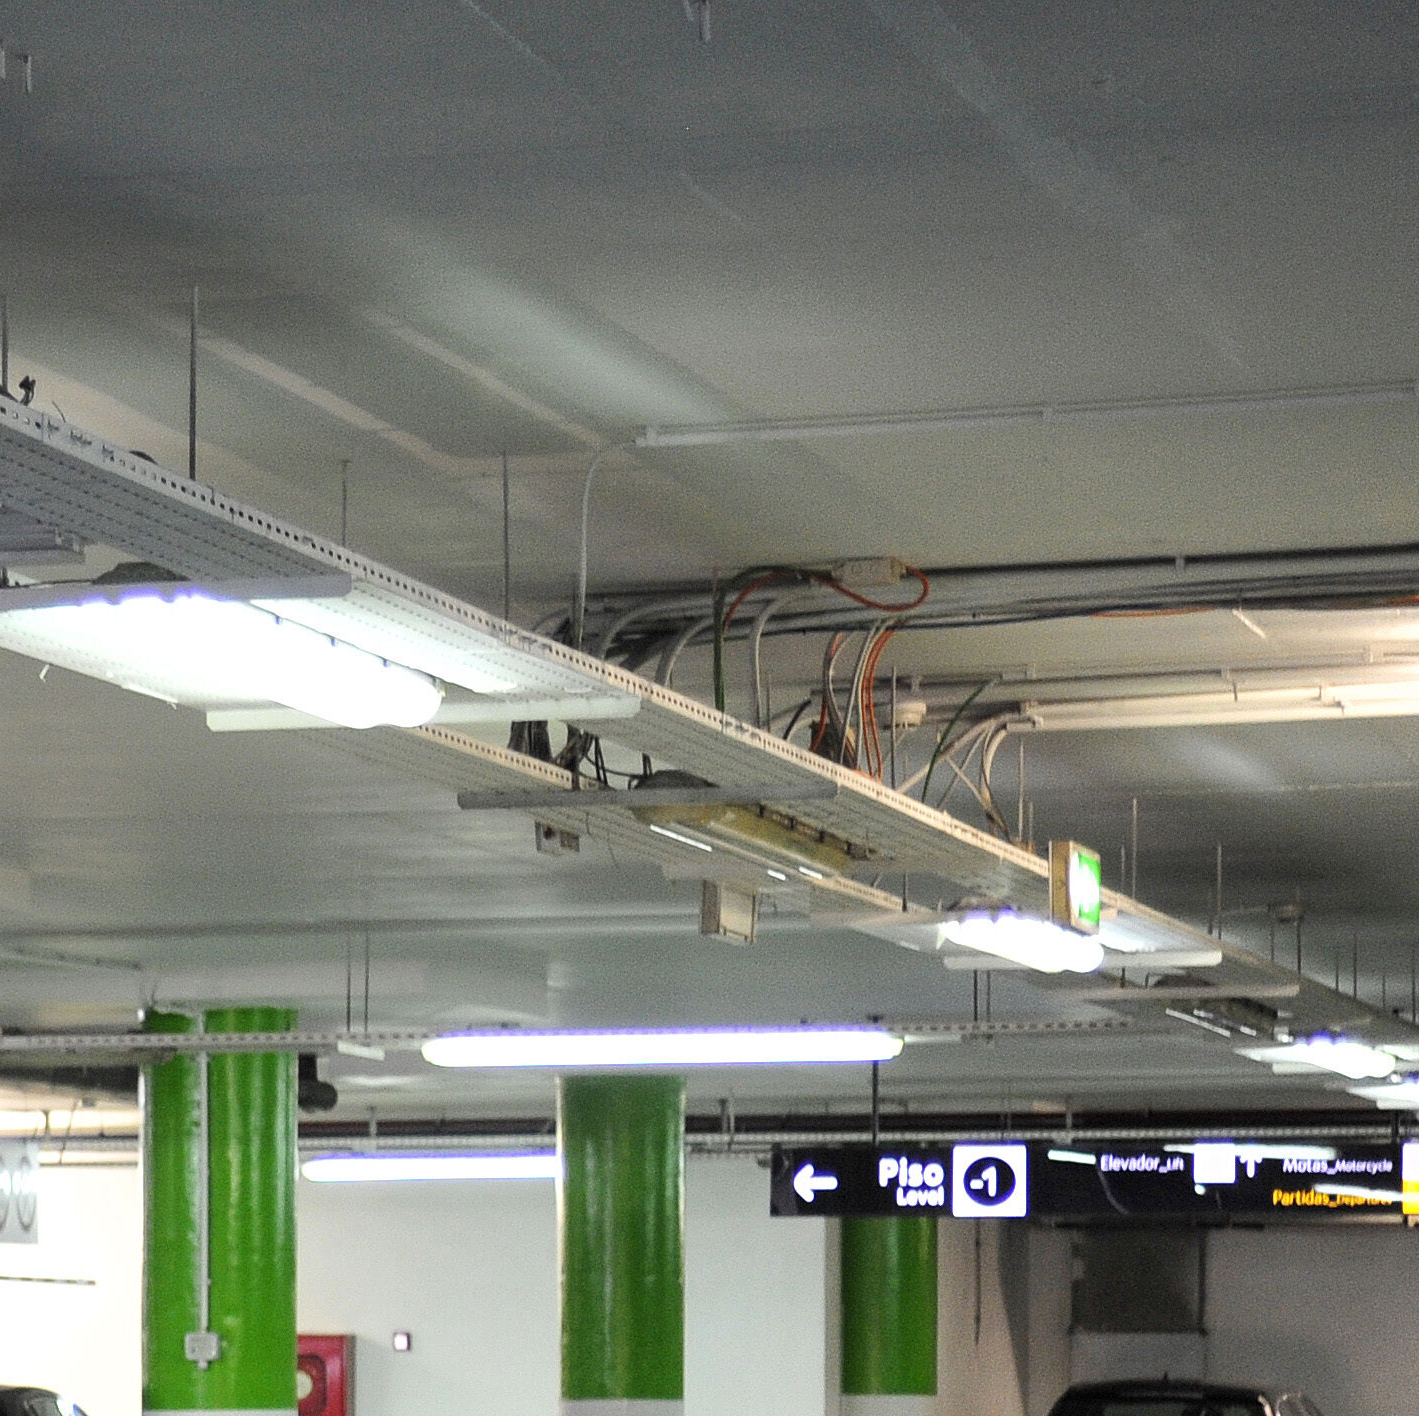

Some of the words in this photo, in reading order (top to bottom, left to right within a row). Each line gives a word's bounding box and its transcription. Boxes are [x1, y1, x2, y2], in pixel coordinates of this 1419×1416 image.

[878, 1156, 945, 1188] Piso
[969, 1165, 997, 1198] -1
[896, 1185, 945, 1207] Level
